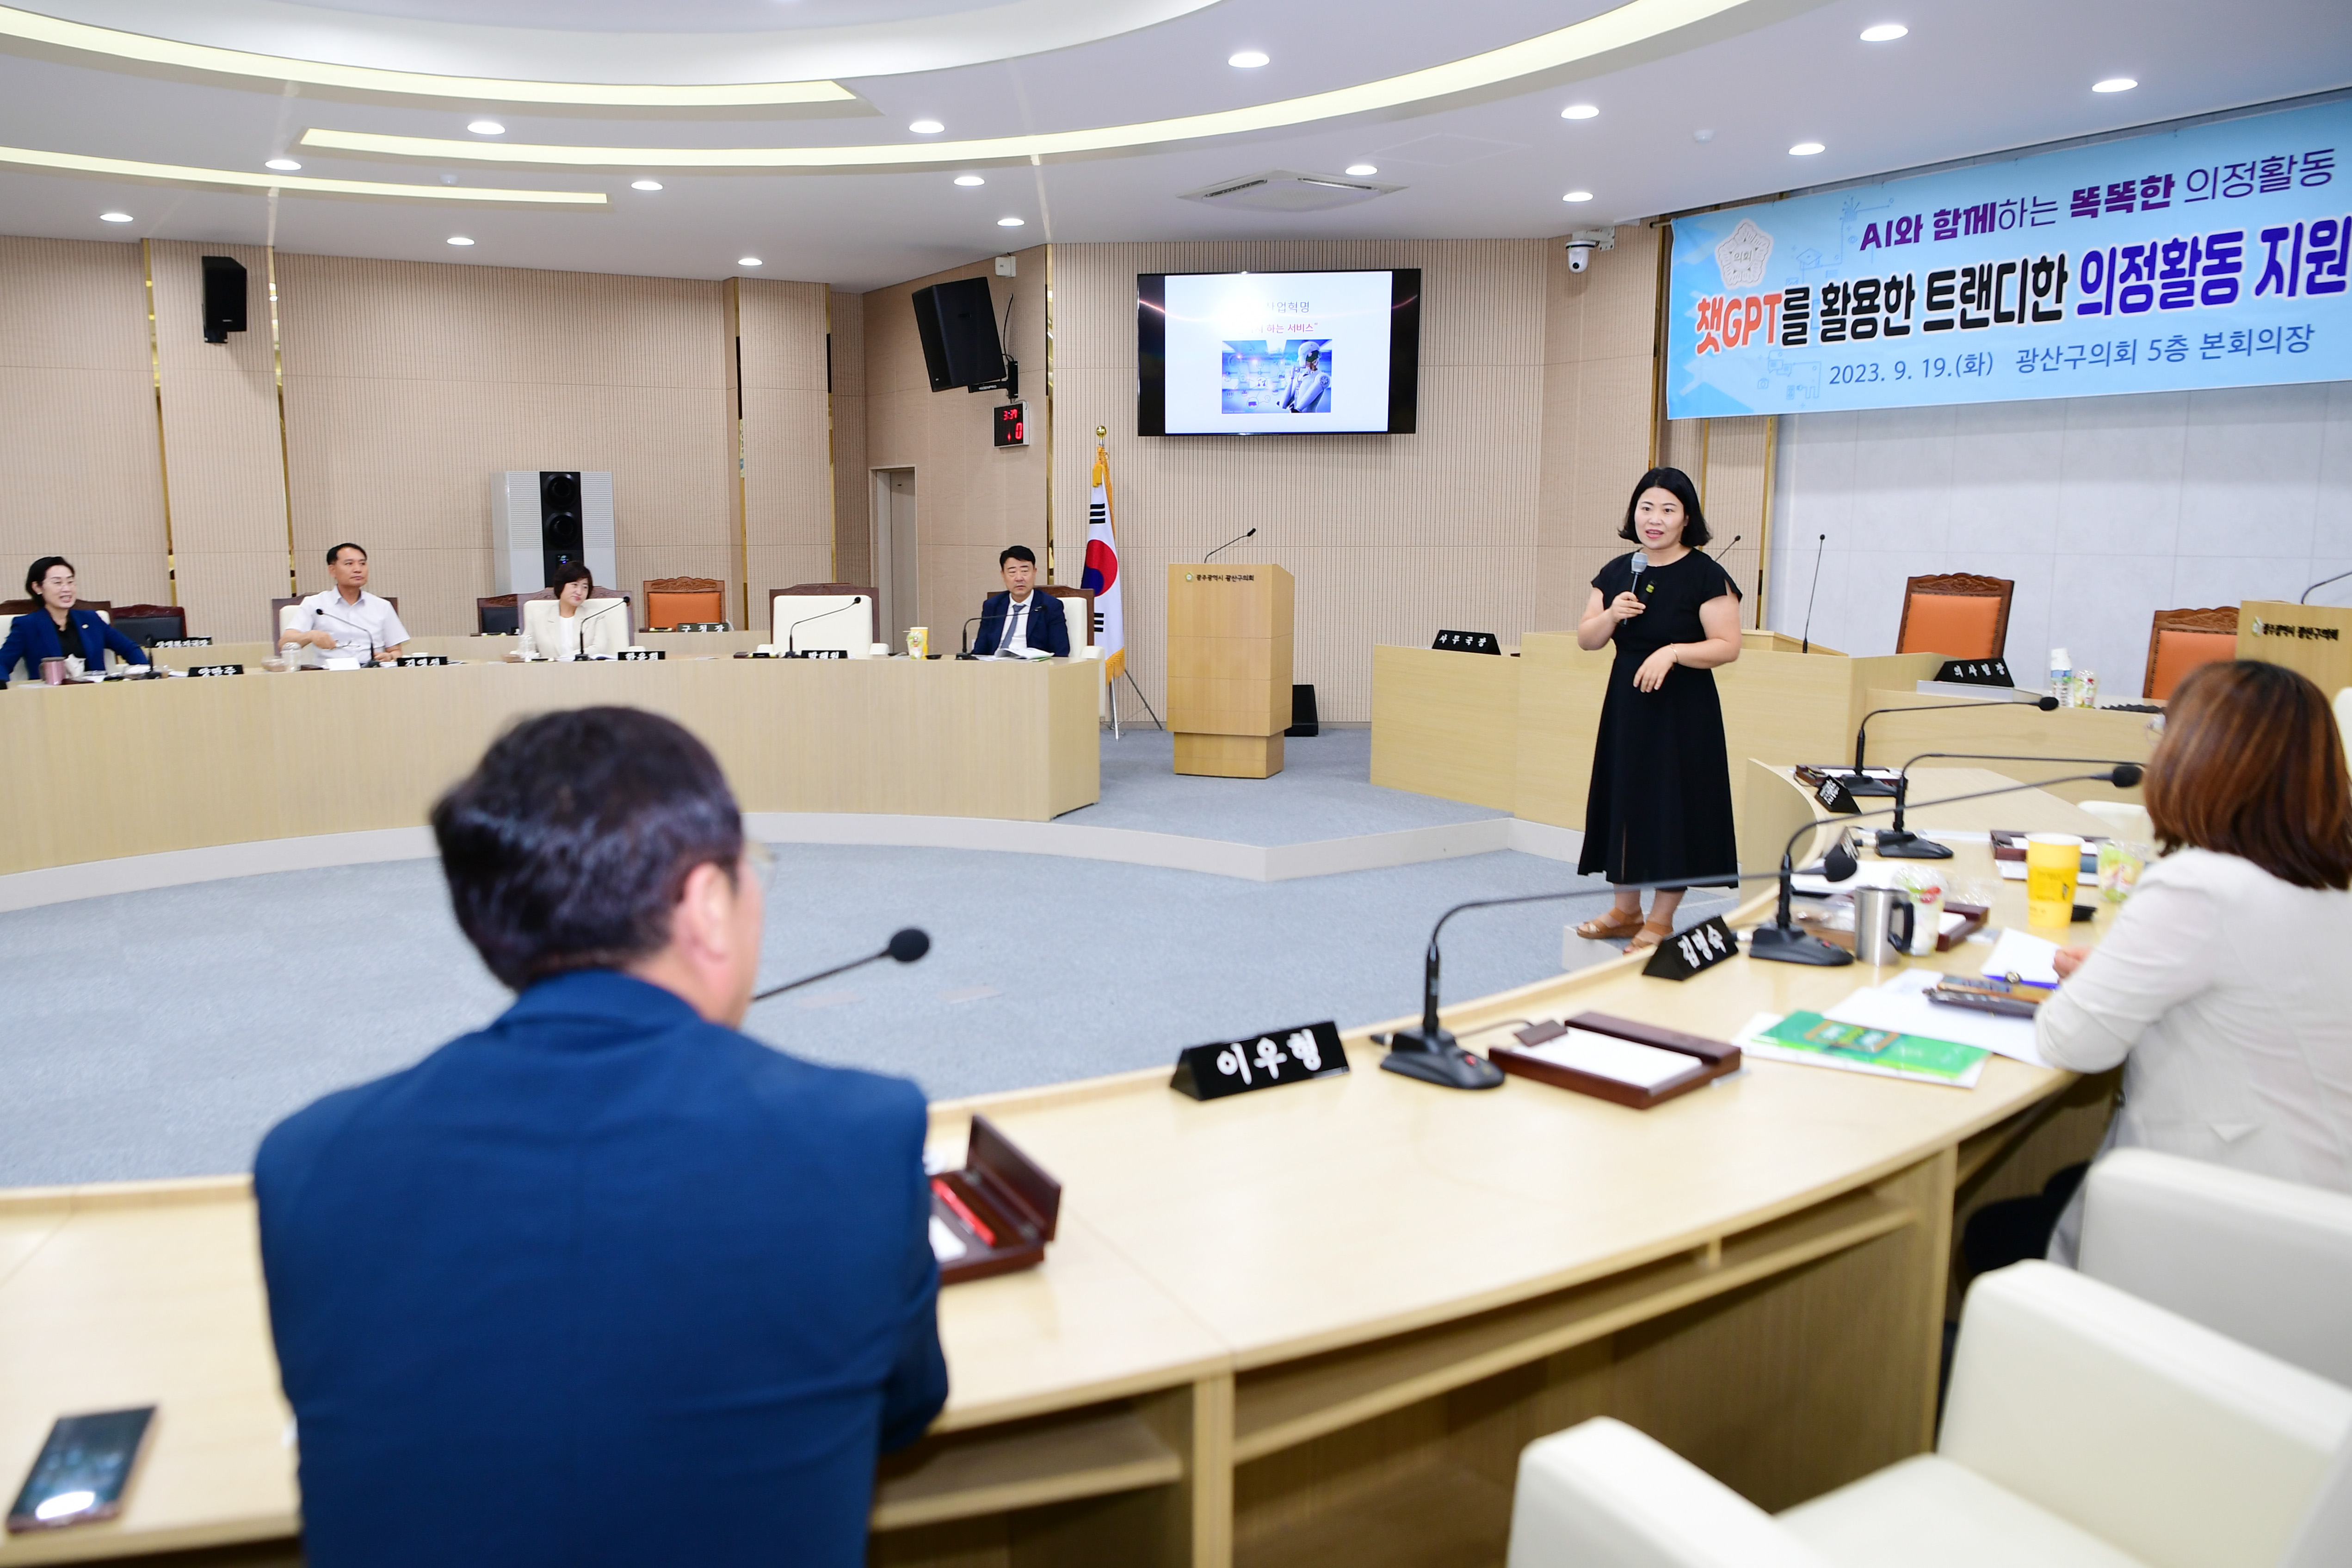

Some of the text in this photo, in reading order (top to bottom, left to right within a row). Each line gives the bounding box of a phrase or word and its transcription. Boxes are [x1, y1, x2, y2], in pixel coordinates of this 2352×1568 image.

[1859, 148, 2335, 251] AI와 함께하는 똑똑한 의정활동
[1697, 215, 2352, 354] 챗GPT를 활용한 트랜디한 의정활동 지원
[1829, 363, 1885, 384] 2023.
[1894, 361, 1912, 380] 9.
[2016, 339, 2137, 374] 광산구의회
[2148, 335, 2189, 363] 5층
[2199, 323, 2315, 361] 본회의장
[1438, 634, 1487, 647] 사무국장
[1216, 1028, 1321, 1086] 이우형
